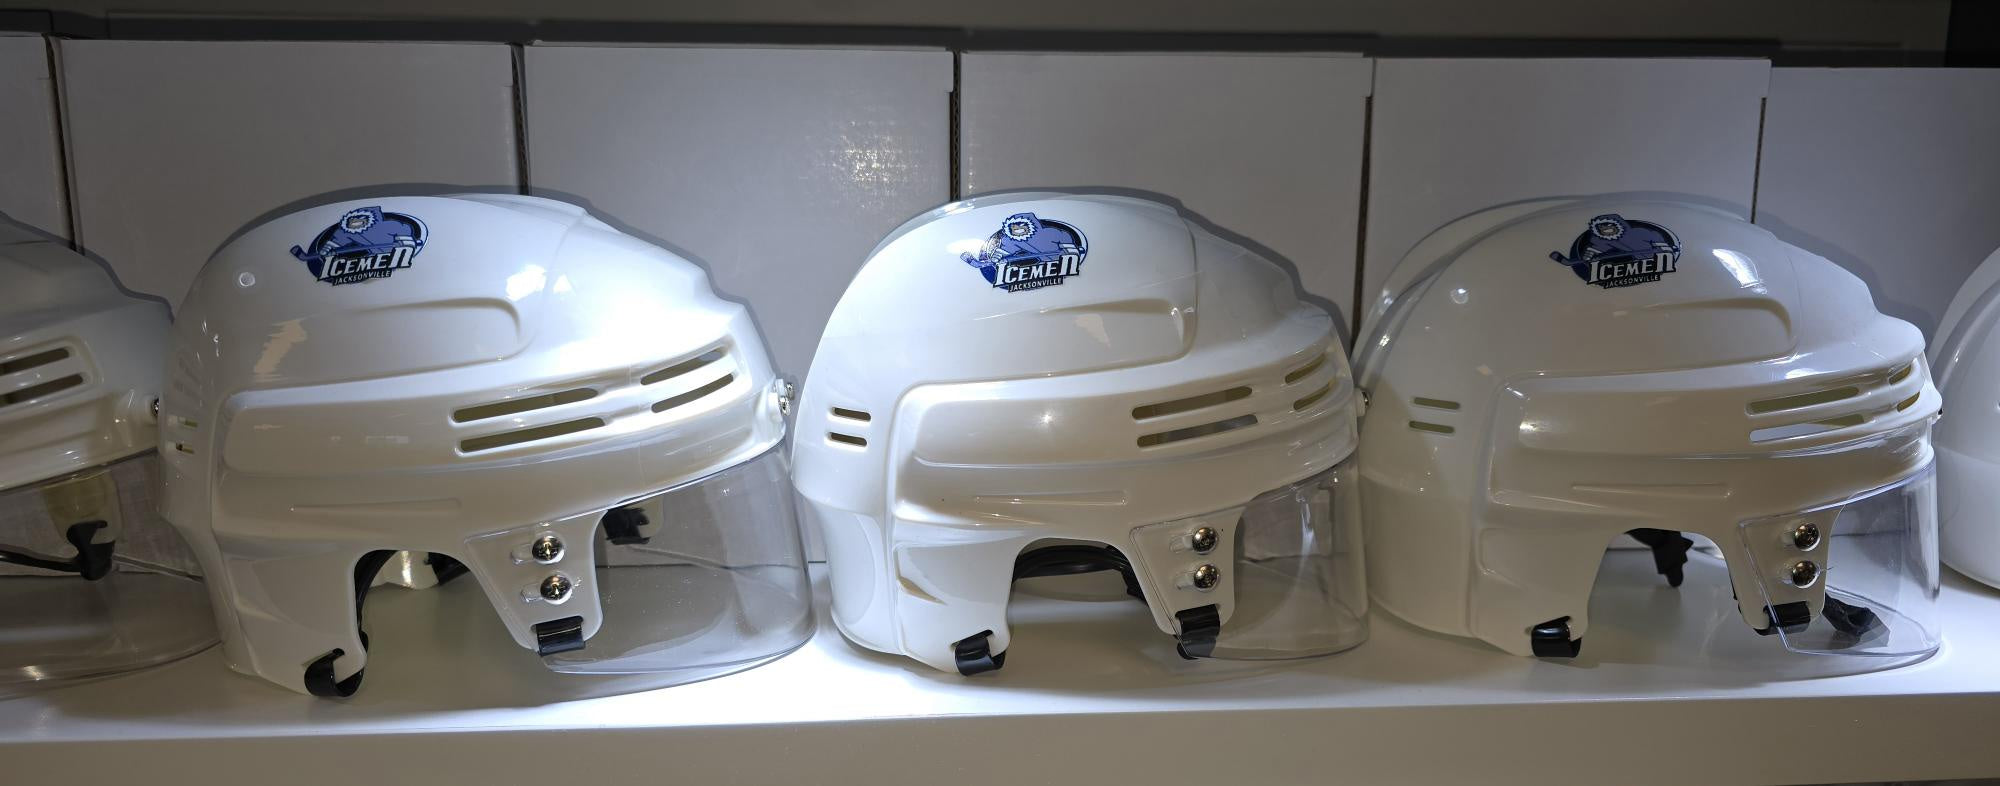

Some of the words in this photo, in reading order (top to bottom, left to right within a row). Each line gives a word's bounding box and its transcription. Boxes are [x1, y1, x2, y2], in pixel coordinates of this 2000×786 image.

[320, 246, 413, 281] ICEMEN
[994, 254, 1080, 286] ICEMEN
[1588, 252, 1676, 283] ICEMEN
[334, 270, 391, 285] JACKSONVILLE
[1009, 277, 1062, 292] JACKSONVILLE
[1605, 274, 1659, 288] JACKSONVILLE
